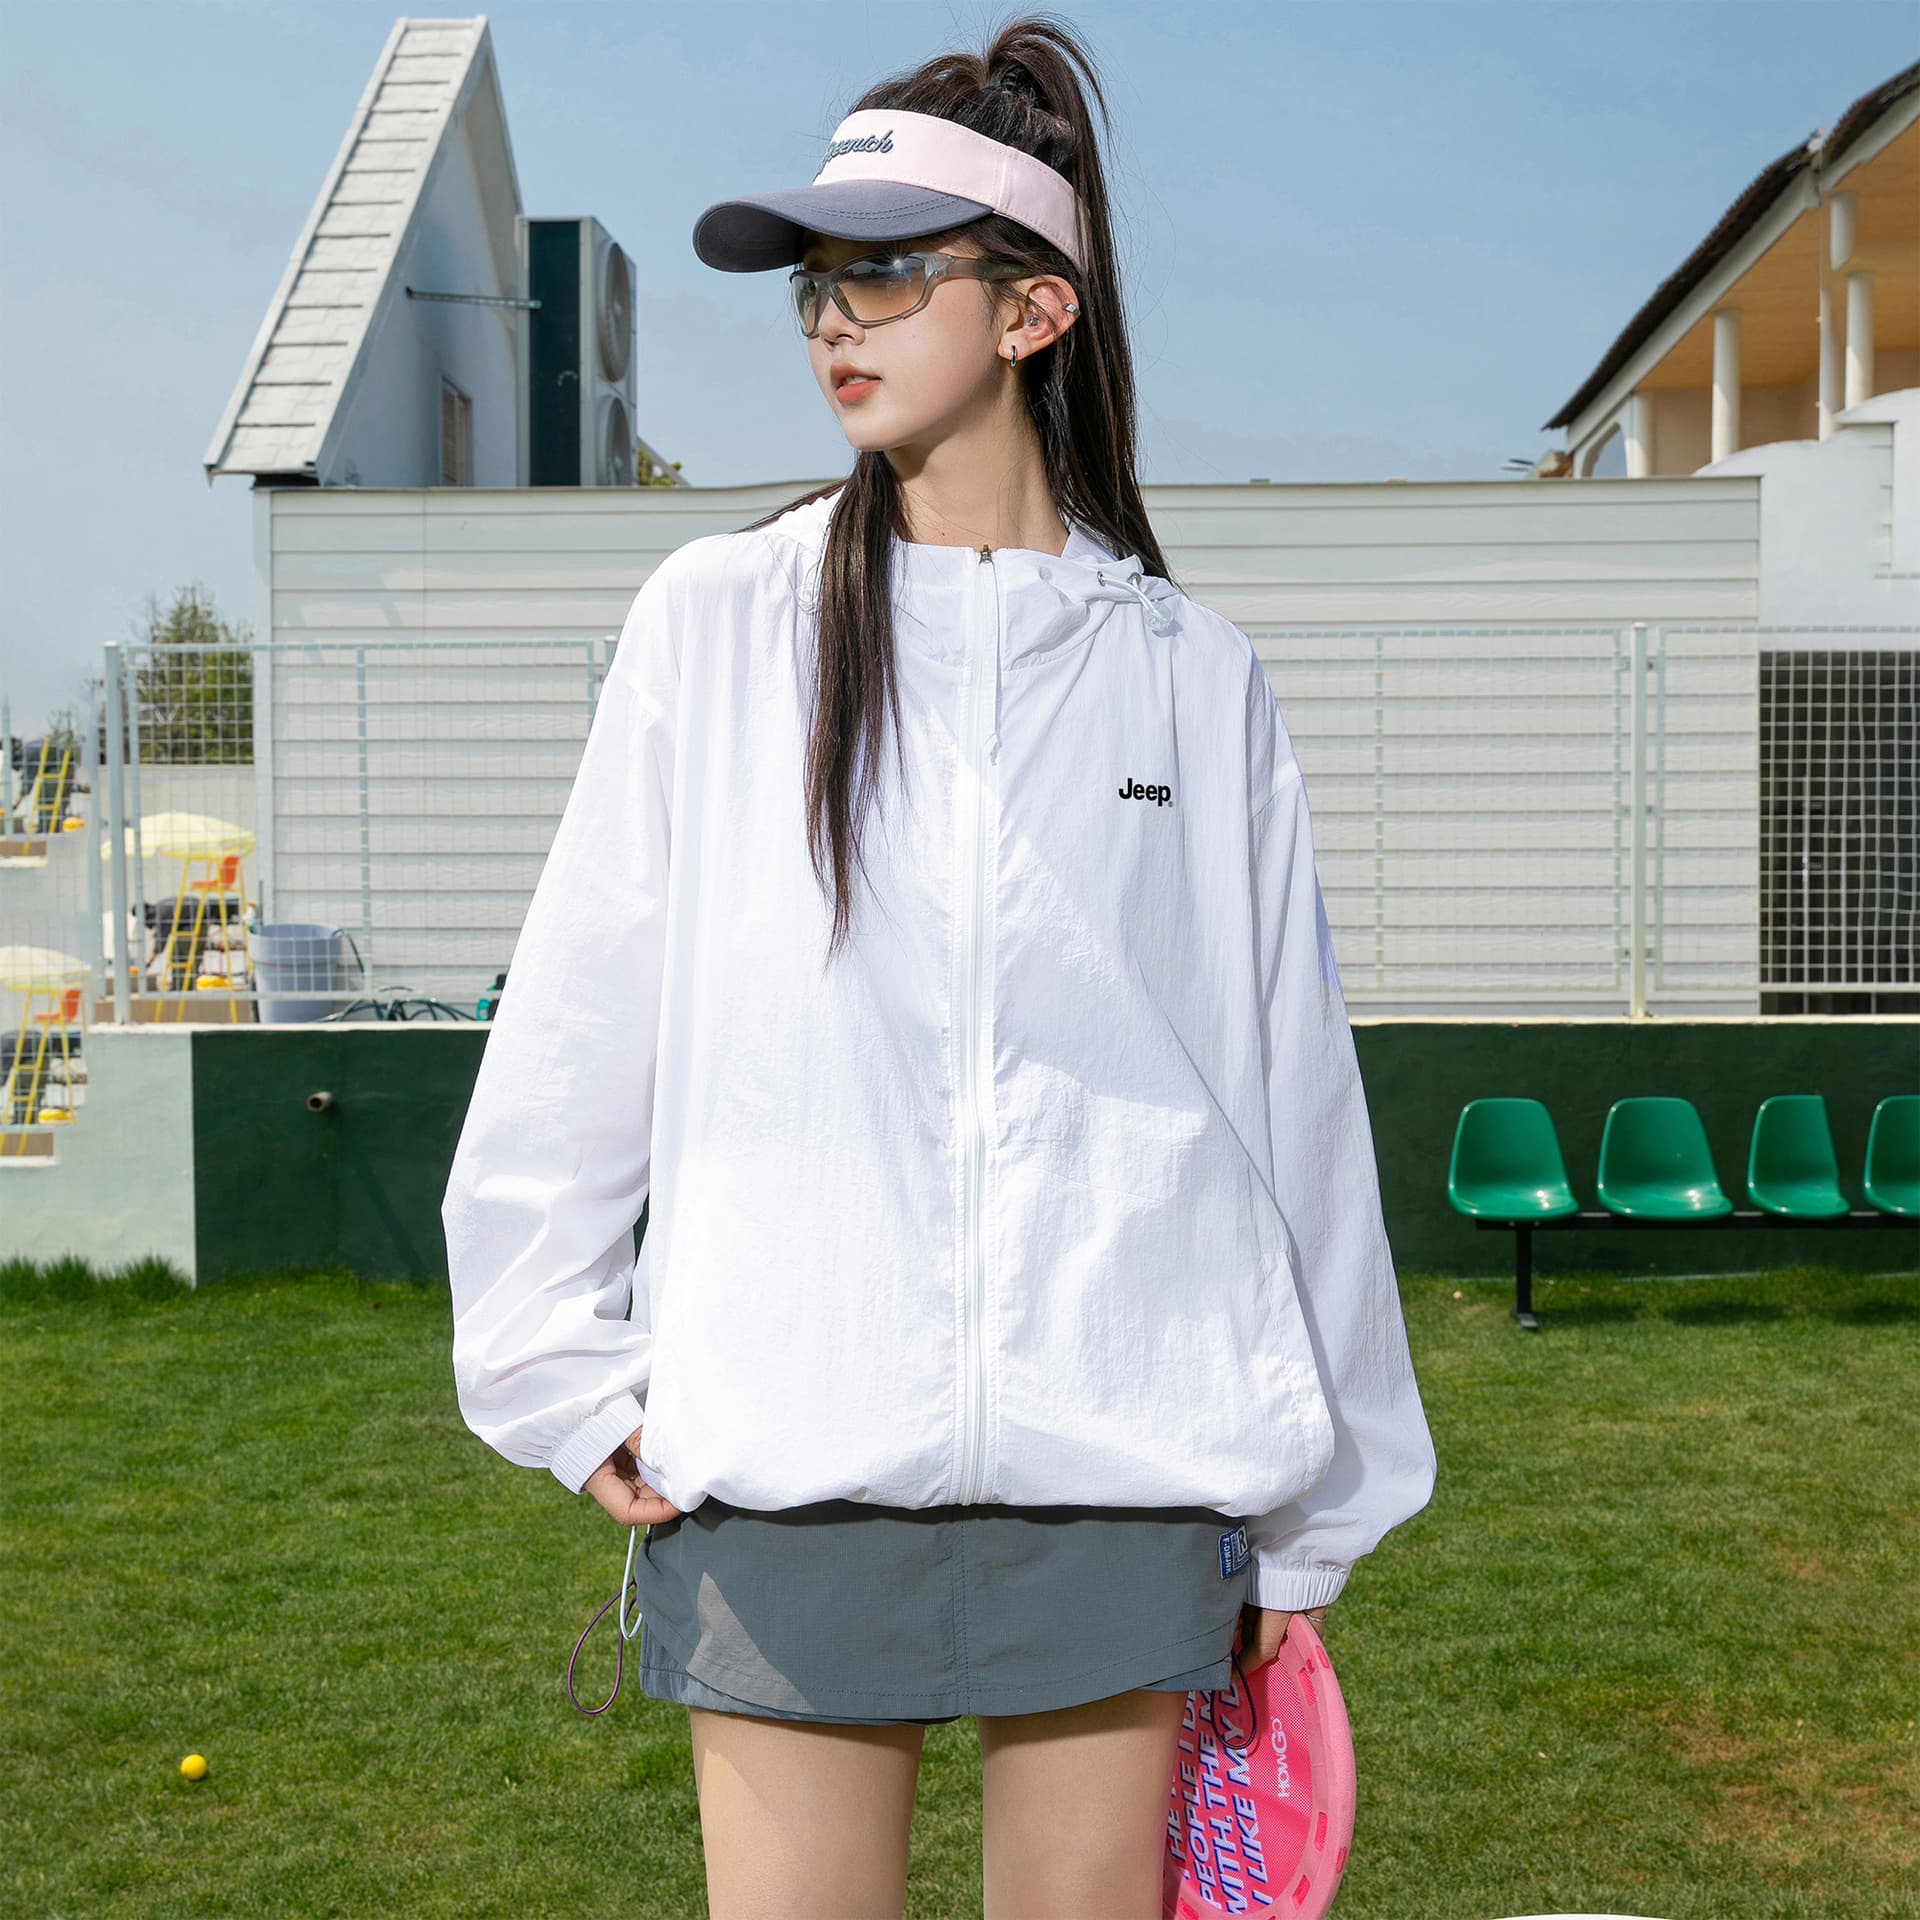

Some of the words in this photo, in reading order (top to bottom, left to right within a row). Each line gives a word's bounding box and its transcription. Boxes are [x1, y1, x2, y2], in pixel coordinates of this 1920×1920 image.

[1118, 777, 1172, 807] Jeep
[1199, 1731, 1227, 1810] THE
[1220, 1713, 1251, 1787] MY
[1180, 1760, 1222, 1909] PEOPLE
[1232, 1794, 1268, 1884] LIKE
